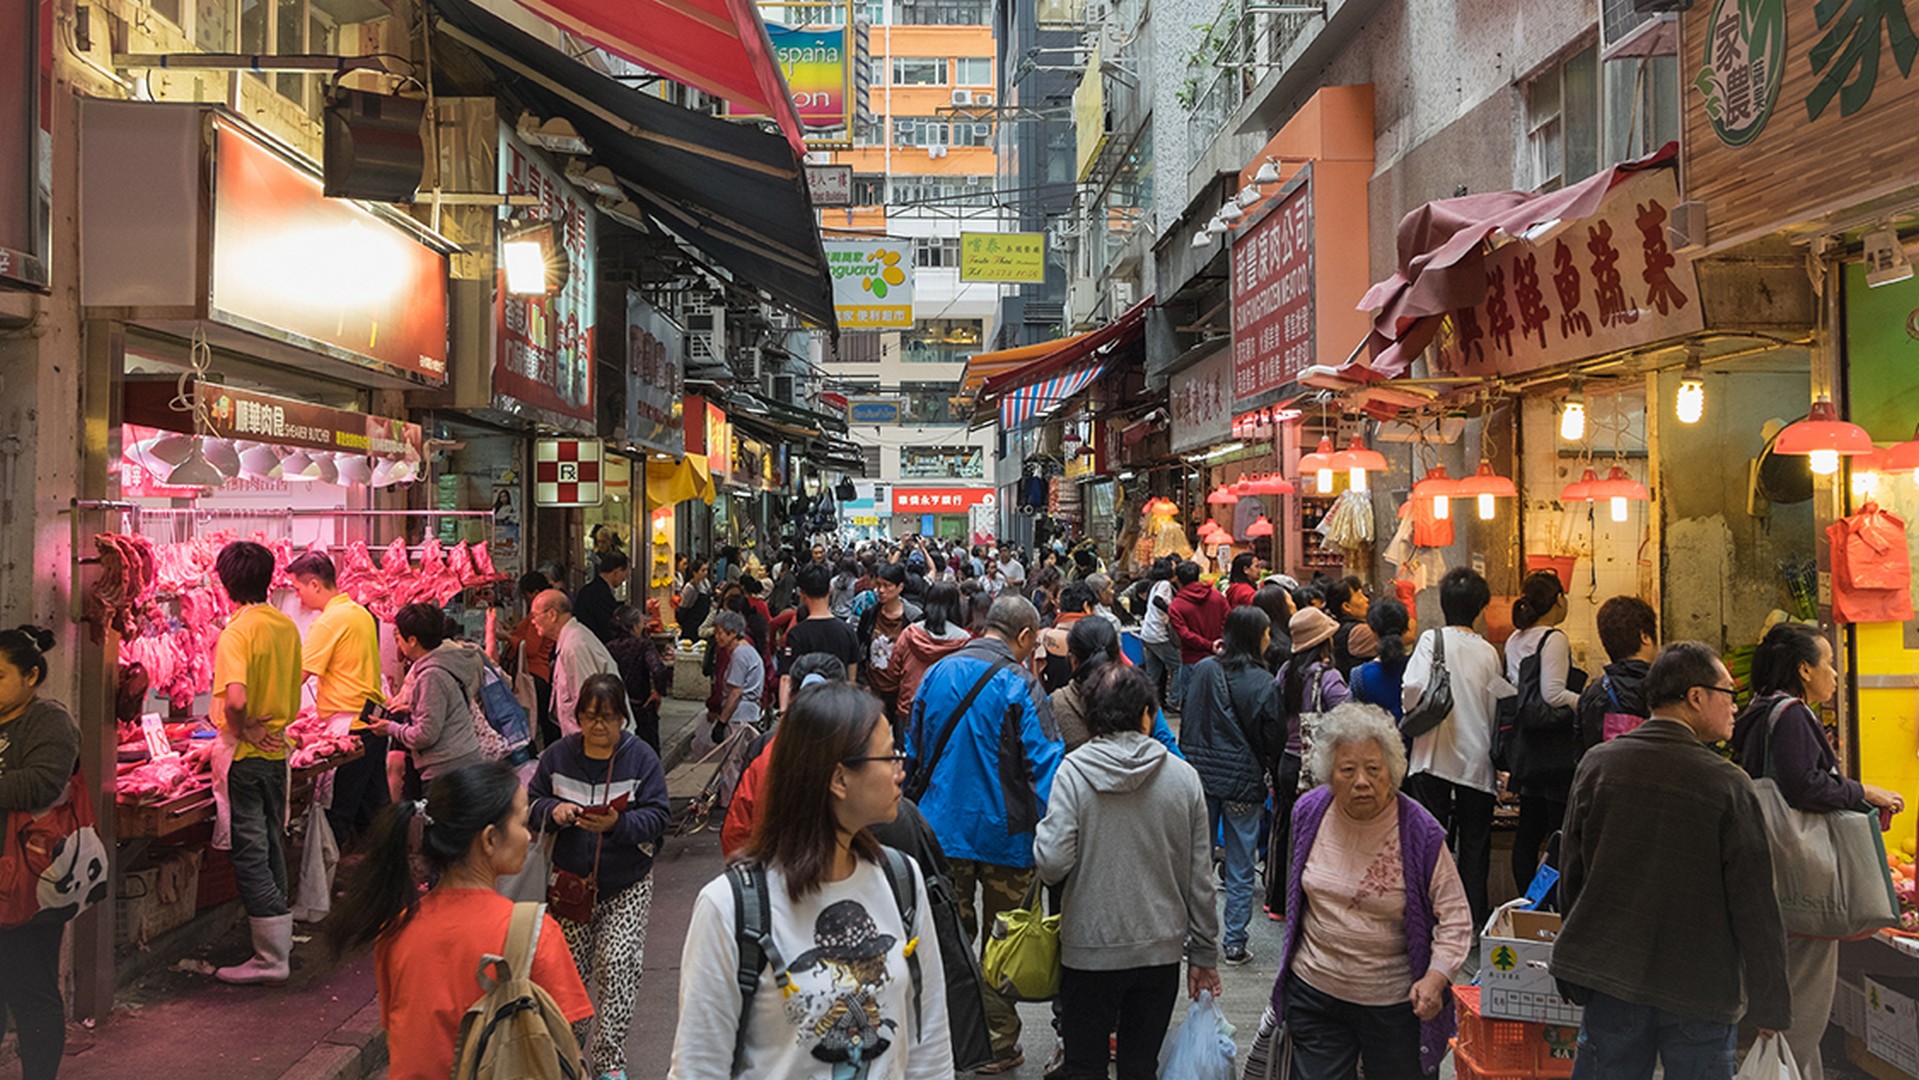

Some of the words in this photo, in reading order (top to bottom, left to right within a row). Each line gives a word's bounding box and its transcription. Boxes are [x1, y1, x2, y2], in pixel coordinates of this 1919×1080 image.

[771, 40, 839, 76] spaña
[826, 251, 864, 263] 潤萬家
[829, 262, 879, 279] nguard
[146, 728, 170, 757] 18
